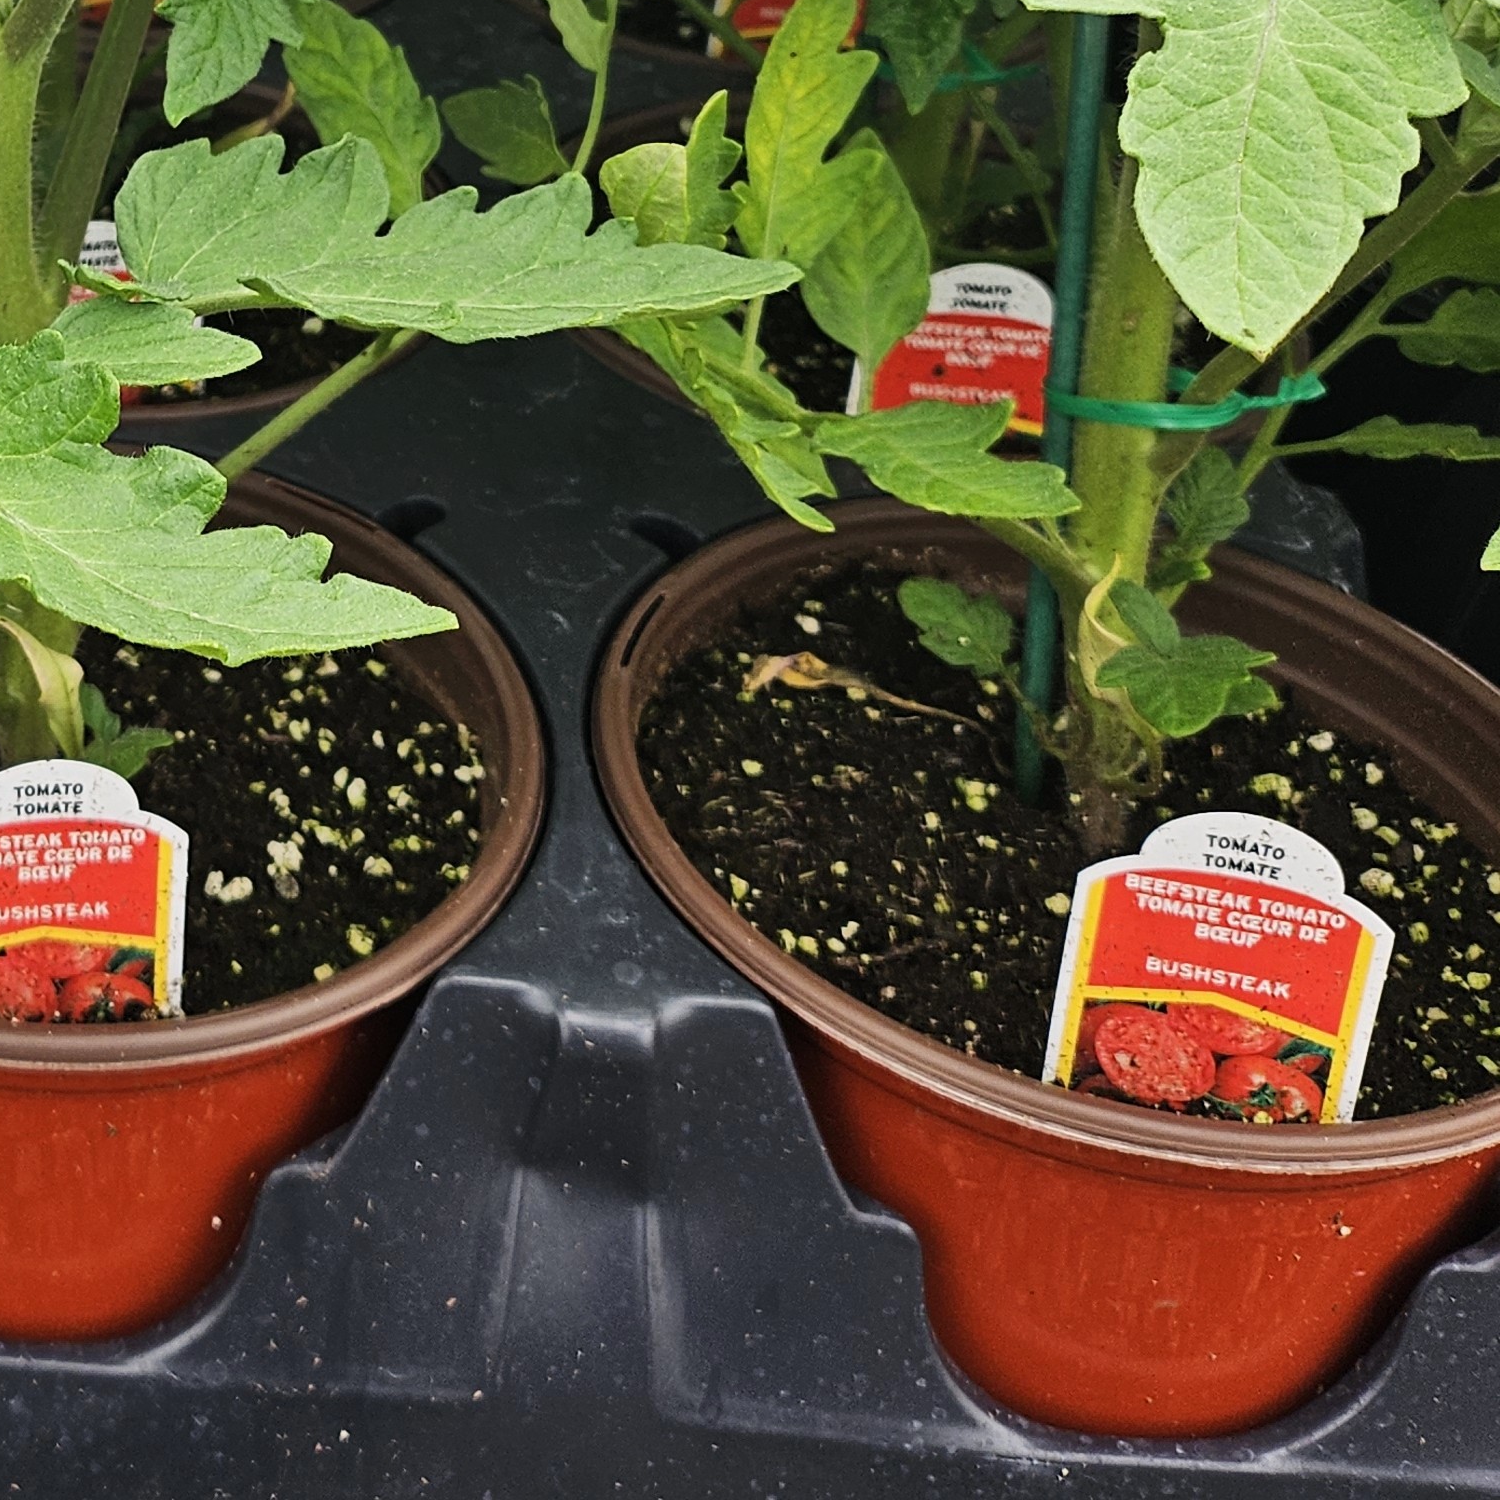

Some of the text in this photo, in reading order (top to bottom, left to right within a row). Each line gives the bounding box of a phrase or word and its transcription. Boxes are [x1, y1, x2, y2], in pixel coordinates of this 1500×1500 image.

[14, 783, 83, 798] TOMATO
[14, 801, 83, 816] TOMATE
[69, 829, 146, 847] TOMATO
[1206, 834, 1285, 860] TOMATO
[44, 848, 102, 865] CŒUR
[107, 845, 133, 861] DE
[1203, 854, 1281, 880] TOMATE
[18, 864, 76, 883] BŒUF
[1125, 873, 1346, 929] BEEFSTEAK TOMATO
[1136, 892, 1329, 945] TOMATE CŒUR DE
[1195, 923, 1261, 948] BŒUF
[1146, 956, 1291, 999] BUSHSTEAK
